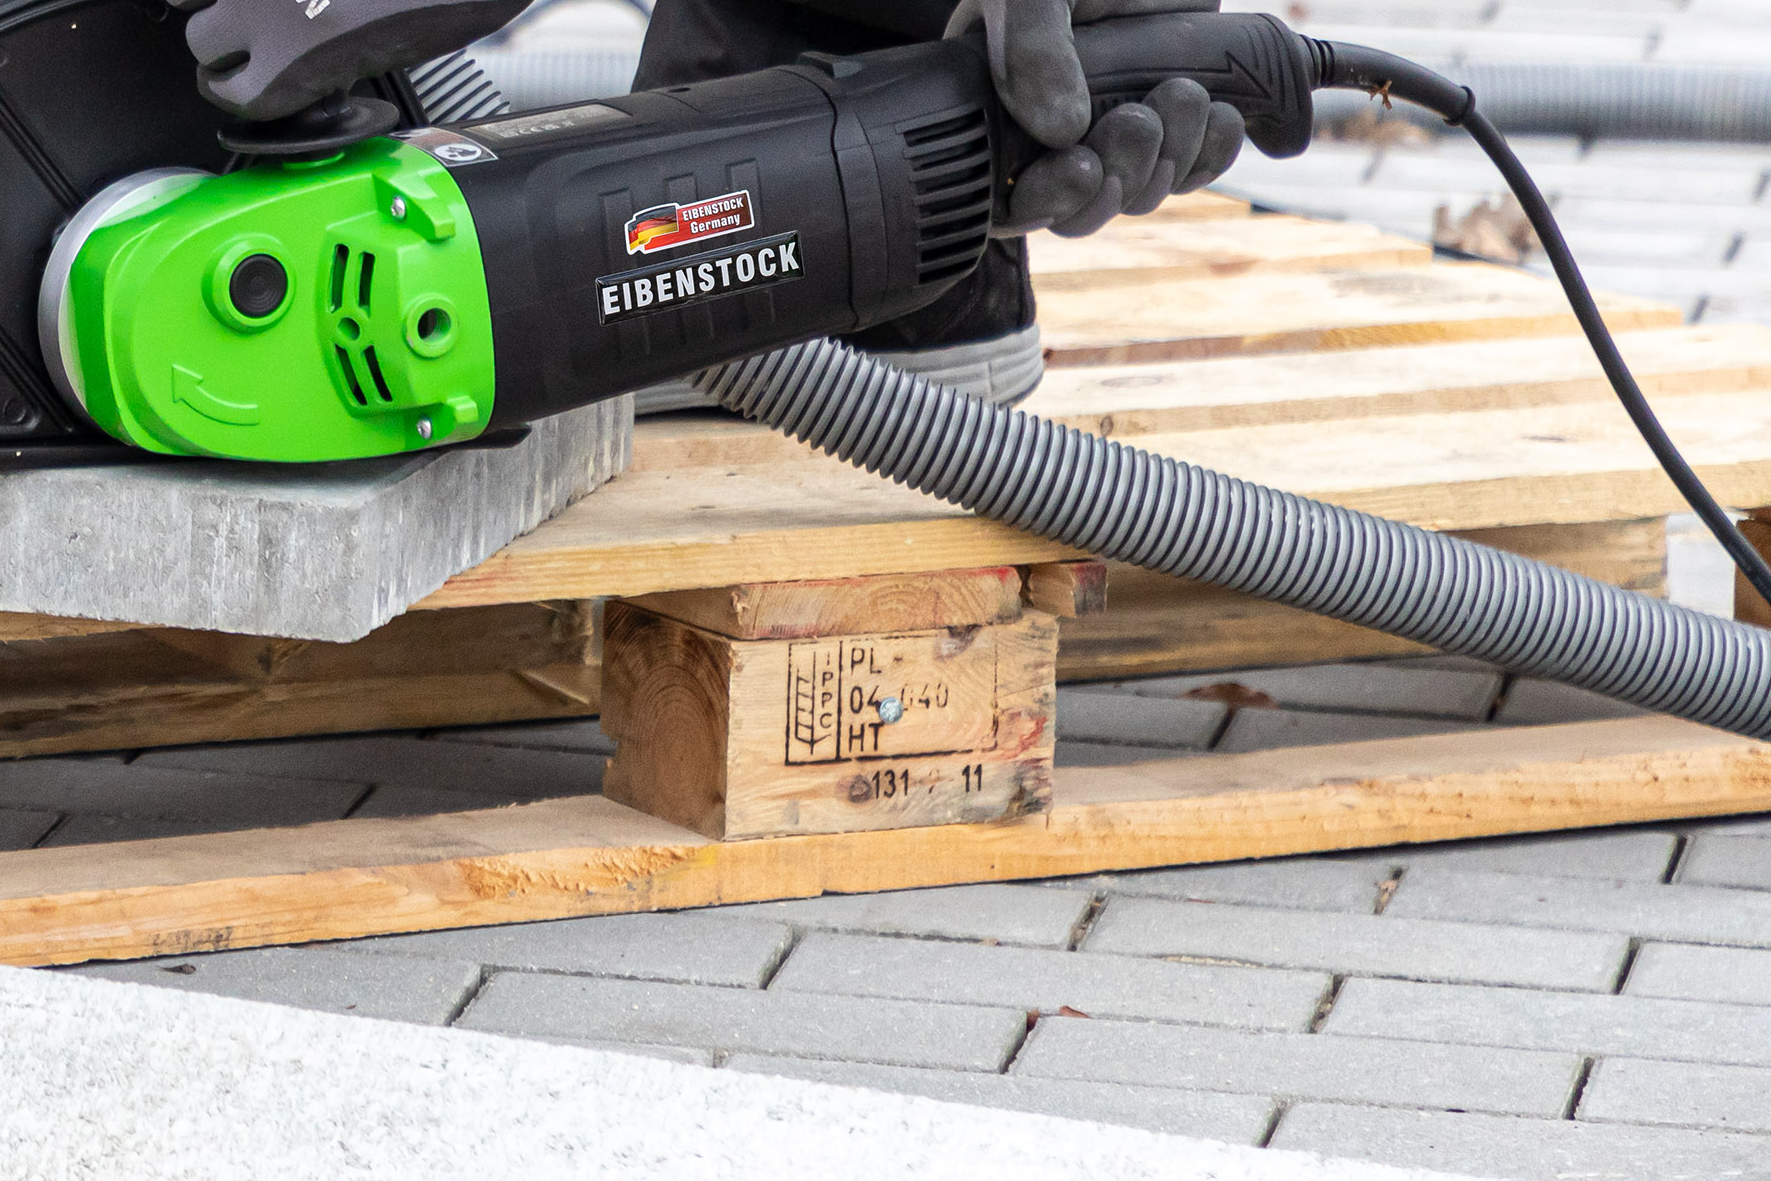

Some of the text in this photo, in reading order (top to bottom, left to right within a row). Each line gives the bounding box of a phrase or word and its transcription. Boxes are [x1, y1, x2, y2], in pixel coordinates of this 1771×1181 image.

[682, 197, 744, 221] EIBENSTOCK
[690, 214, 740, 234] Germany
[602, 242, 799, 315] EIBENSTOCK
[848, 722, 885, 753] HT
[871, 768, 909, 799] 131
[961, 764, 983, 794] 11
